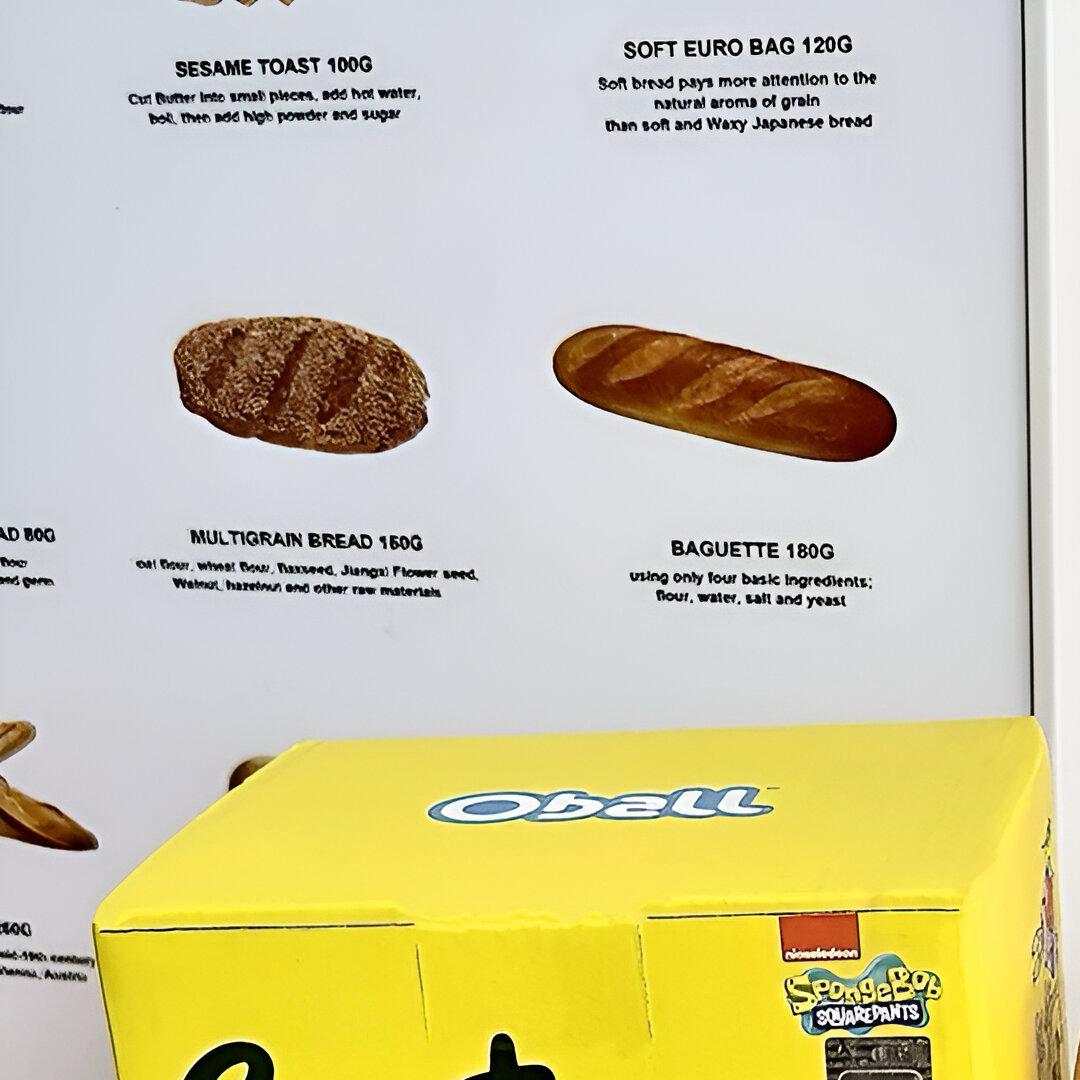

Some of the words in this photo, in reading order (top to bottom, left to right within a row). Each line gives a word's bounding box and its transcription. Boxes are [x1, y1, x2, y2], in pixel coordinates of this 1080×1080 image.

[623, 40, 678, 60] SOFT
[683, 38, 744, 58] EURO
[749, 36, 795, 56] BAG
[802, 34, 853, 54] 120G
[175, 58, 253, 79] SESAME
[256, 56, 321, 76] TOAST
[327, 54, 373, 74] 100G
[597, 76, 628, 91] Soft
[631, 75, 675, 91] bread
[678, 77, 714, 92] pays
[718, 76, 757, 88] more
[761, 72, 829, 87] attention
[833, 72, 850, 86] to
[853, 70, 877, 85] the
[653, 96, 706, 111] natural
[710, 97, 758, 110] aroma
[761, 94, 778, 109] of
[780, 93, 821, 111] grain
[604, 119, 638, 133] than
[641, 117, 671, 132] soft
[674, 117, 703, 131] and
[706, 116, 748, 134] Waxy
[751, 116, 825, 132] Japanese
[828, 113, 873, 129] bread
[189, 529, 303, 548] MULTIGRAIN
[307, 532, 374, 550] BREAD
[670, 539, 780, 559] BAGUETTE
[786, 542, 835, 561] 180G
[313, 583, 349, 595] other
[672, 571, 704, 587] only
[707, 571, 738, 585] four
[775, 593, 803, 606] and
[806, 595, 847, 609] yeast
[428, 787, 774, 824] Oball
[816, 1003, 920, 1027] SQUAREPANTS
